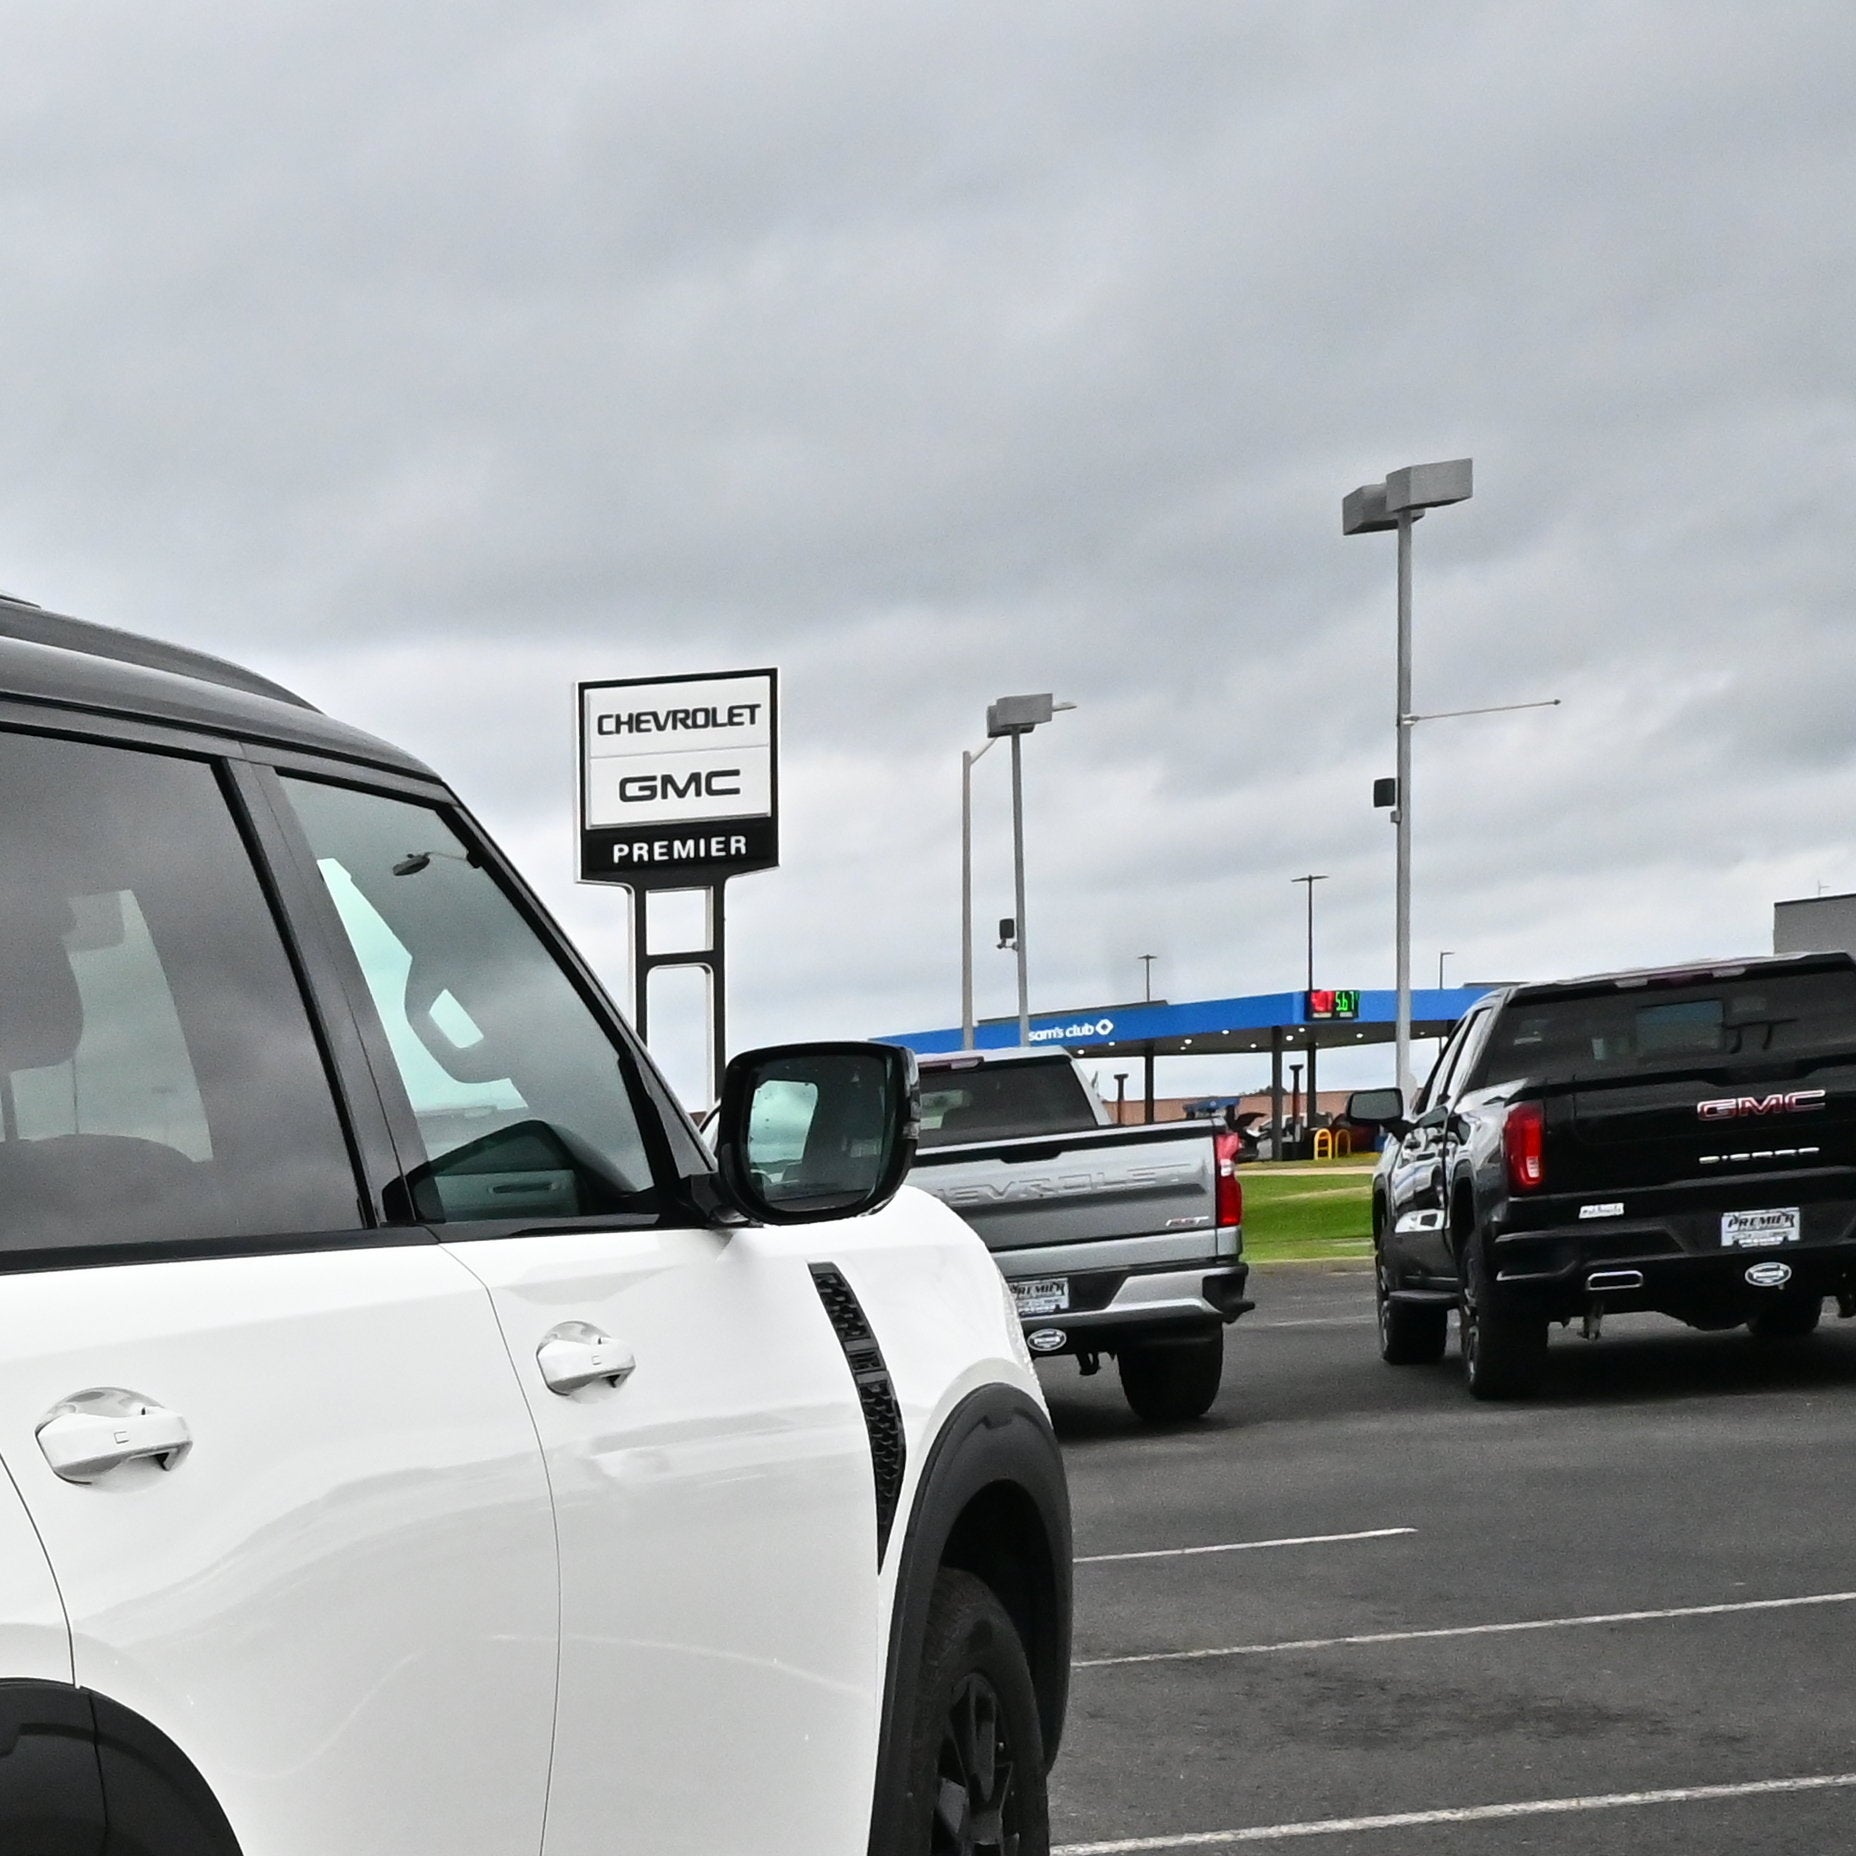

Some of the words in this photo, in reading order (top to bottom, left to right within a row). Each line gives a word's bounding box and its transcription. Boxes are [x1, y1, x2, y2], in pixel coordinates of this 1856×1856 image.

[597, 704, 761, 736] CHEVROLET
[619, 769, 741, 802] GMC
[613, 836, 747, 864] PREMIER
[1028, 1027, 1064, 1041] sam's
[1065, 1022, 1095, 1037] club
[1697, 1089, 1826, 1121] GMC
